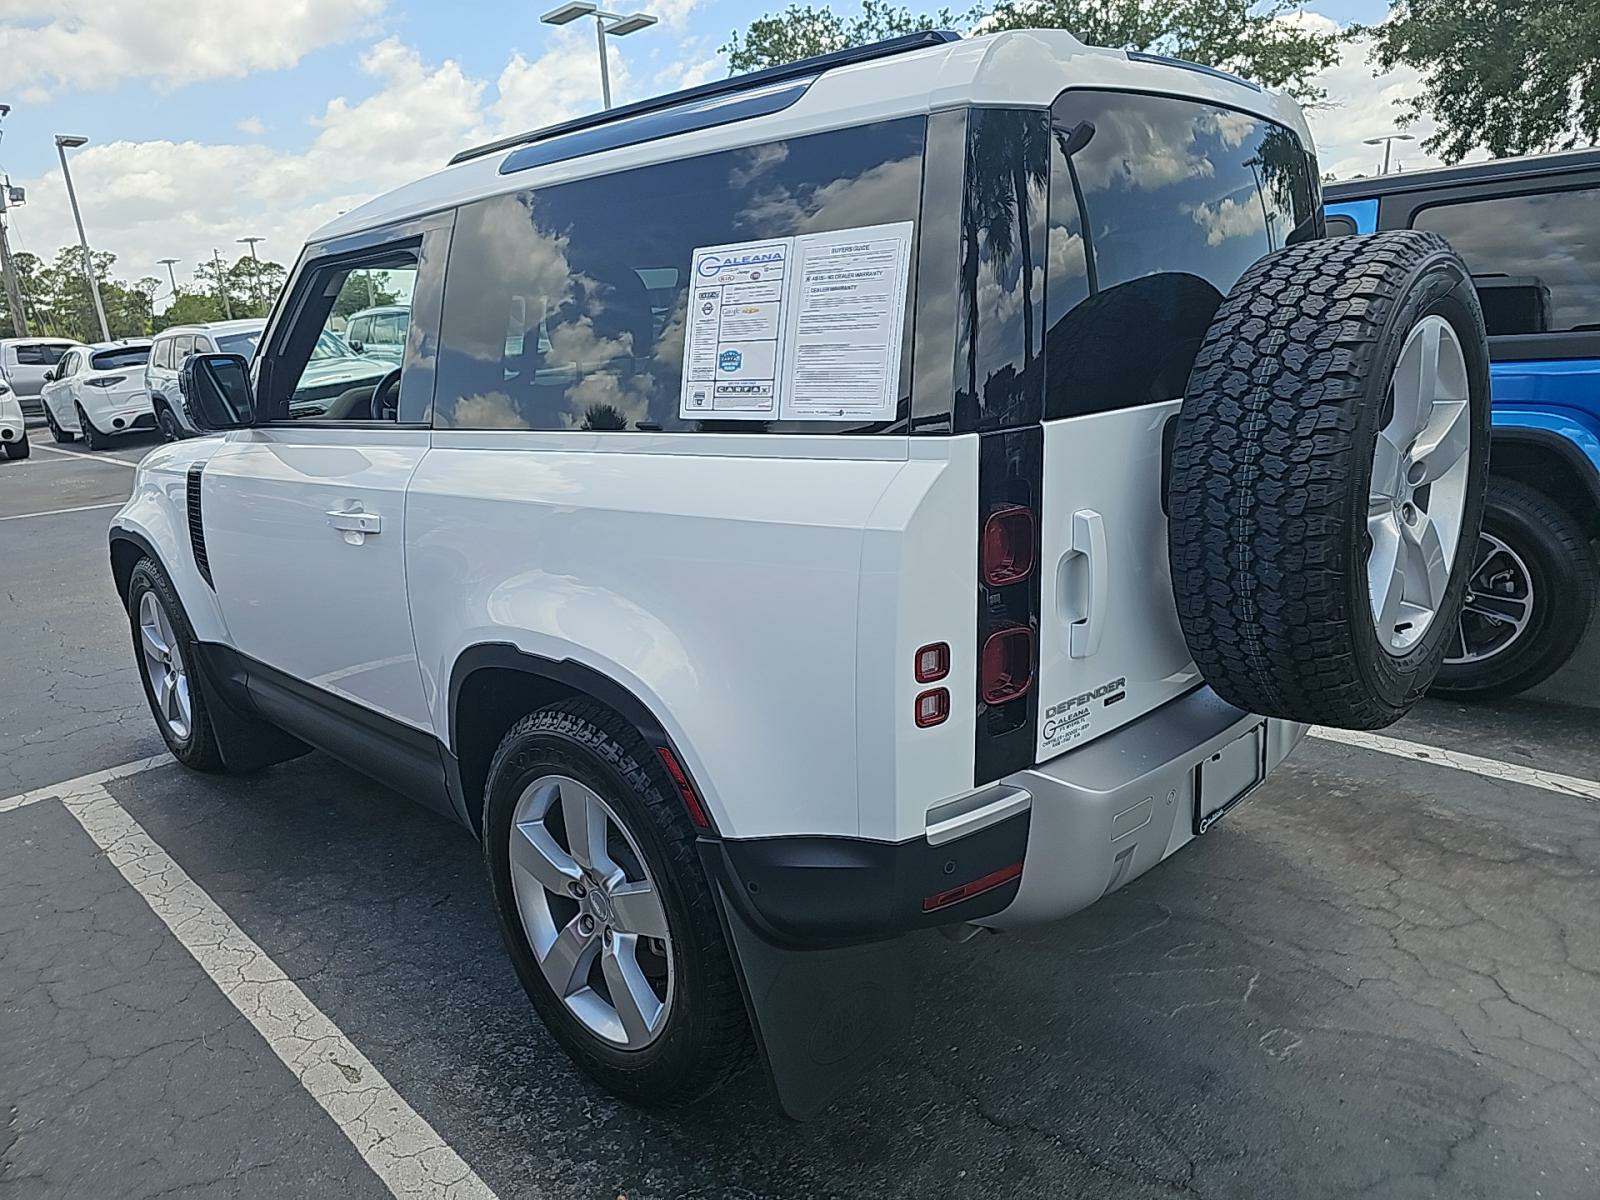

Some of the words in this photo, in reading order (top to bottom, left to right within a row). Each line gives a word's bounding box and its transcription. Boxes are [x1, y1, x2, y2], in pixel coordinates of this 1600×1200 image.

[698, 252, 783, 277] GALEANA
[717, 385, 769, 393] CARFAX
[1046, 677, 1125, 719] DEFENDER
[1042, 707, 1091, 741] GALEANA
